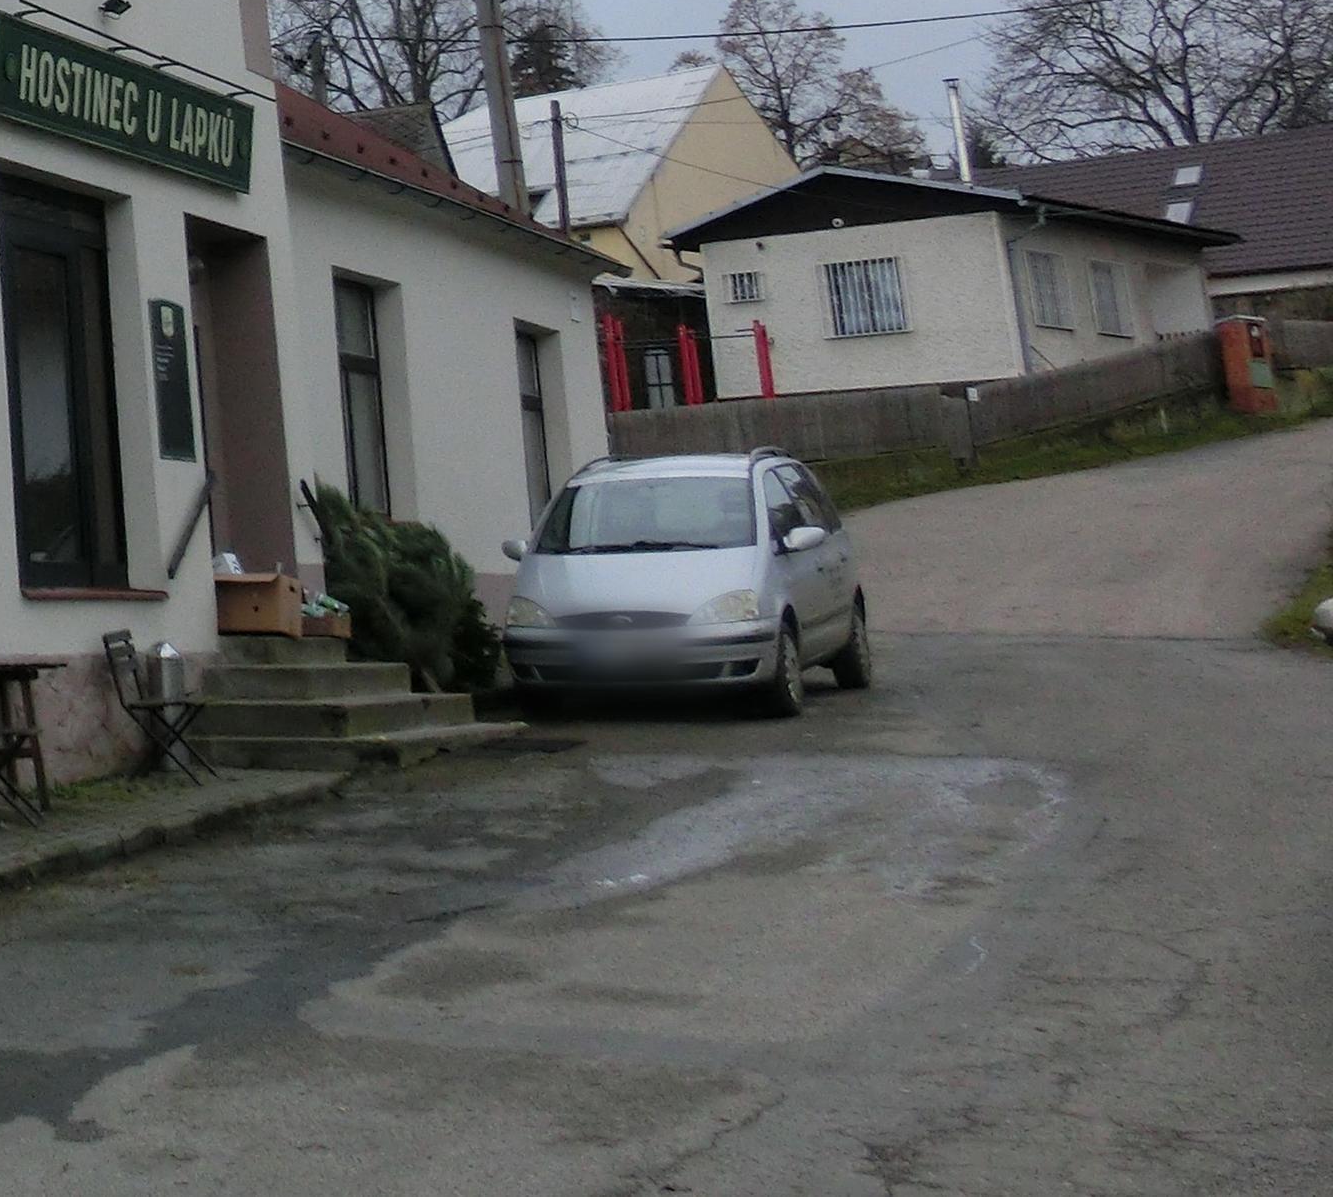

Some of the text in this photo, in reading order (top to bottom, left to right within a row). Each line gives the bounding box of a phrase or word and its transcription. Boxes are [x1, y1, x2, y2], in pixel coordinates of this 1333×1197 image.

[19, 43, 234, 168] HOSTINEC U LAPKŮ
